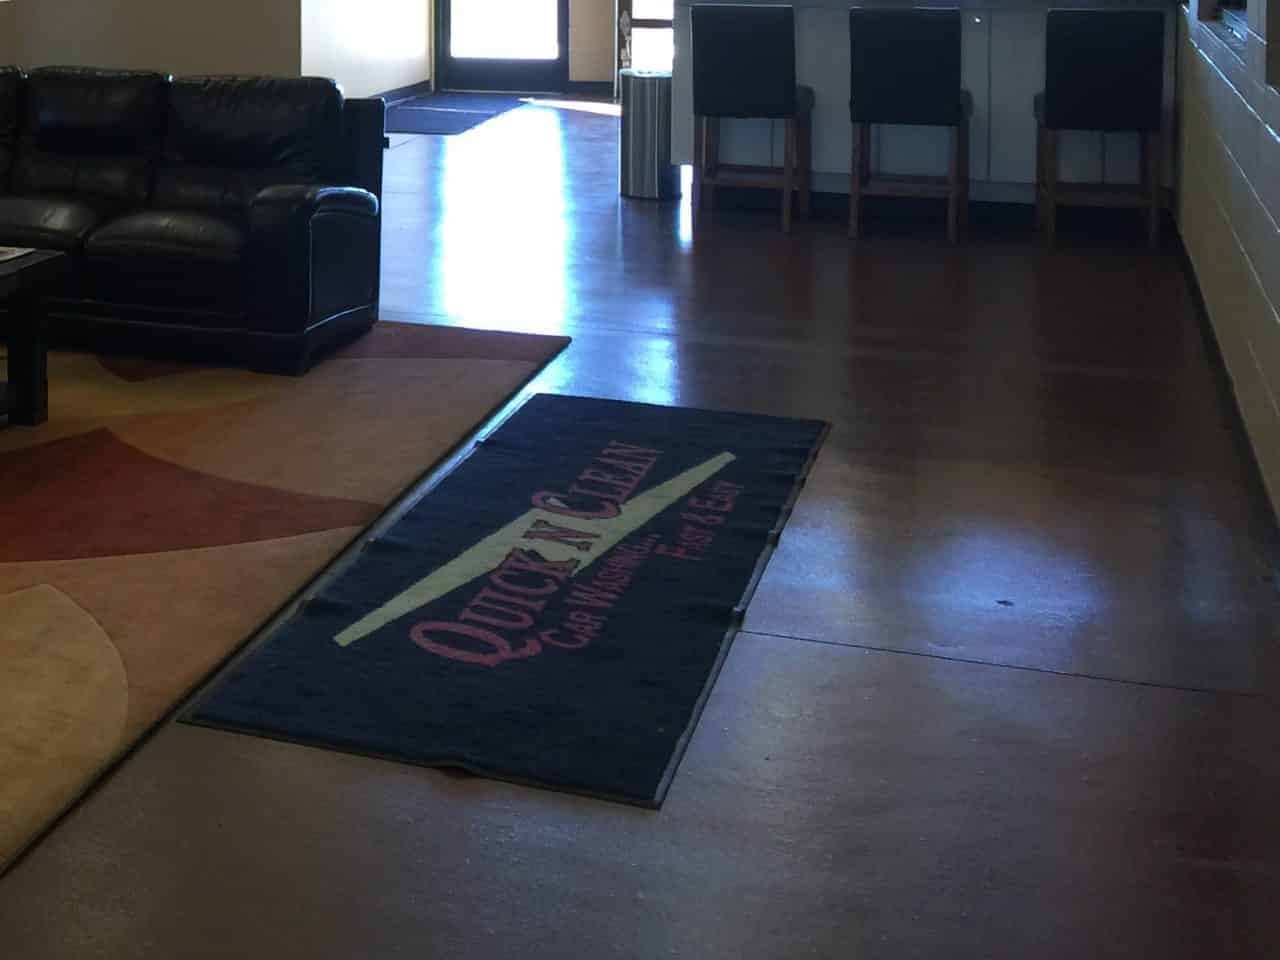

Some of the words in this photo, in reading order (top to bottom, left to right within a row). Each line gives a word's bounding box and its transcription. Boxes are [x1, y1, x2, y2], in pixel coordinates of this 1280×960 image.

[408, 546, 581, 668] QUICK
[531, 440, 658, 520] CLEAN
[540, 613, 610, 651] CAR
